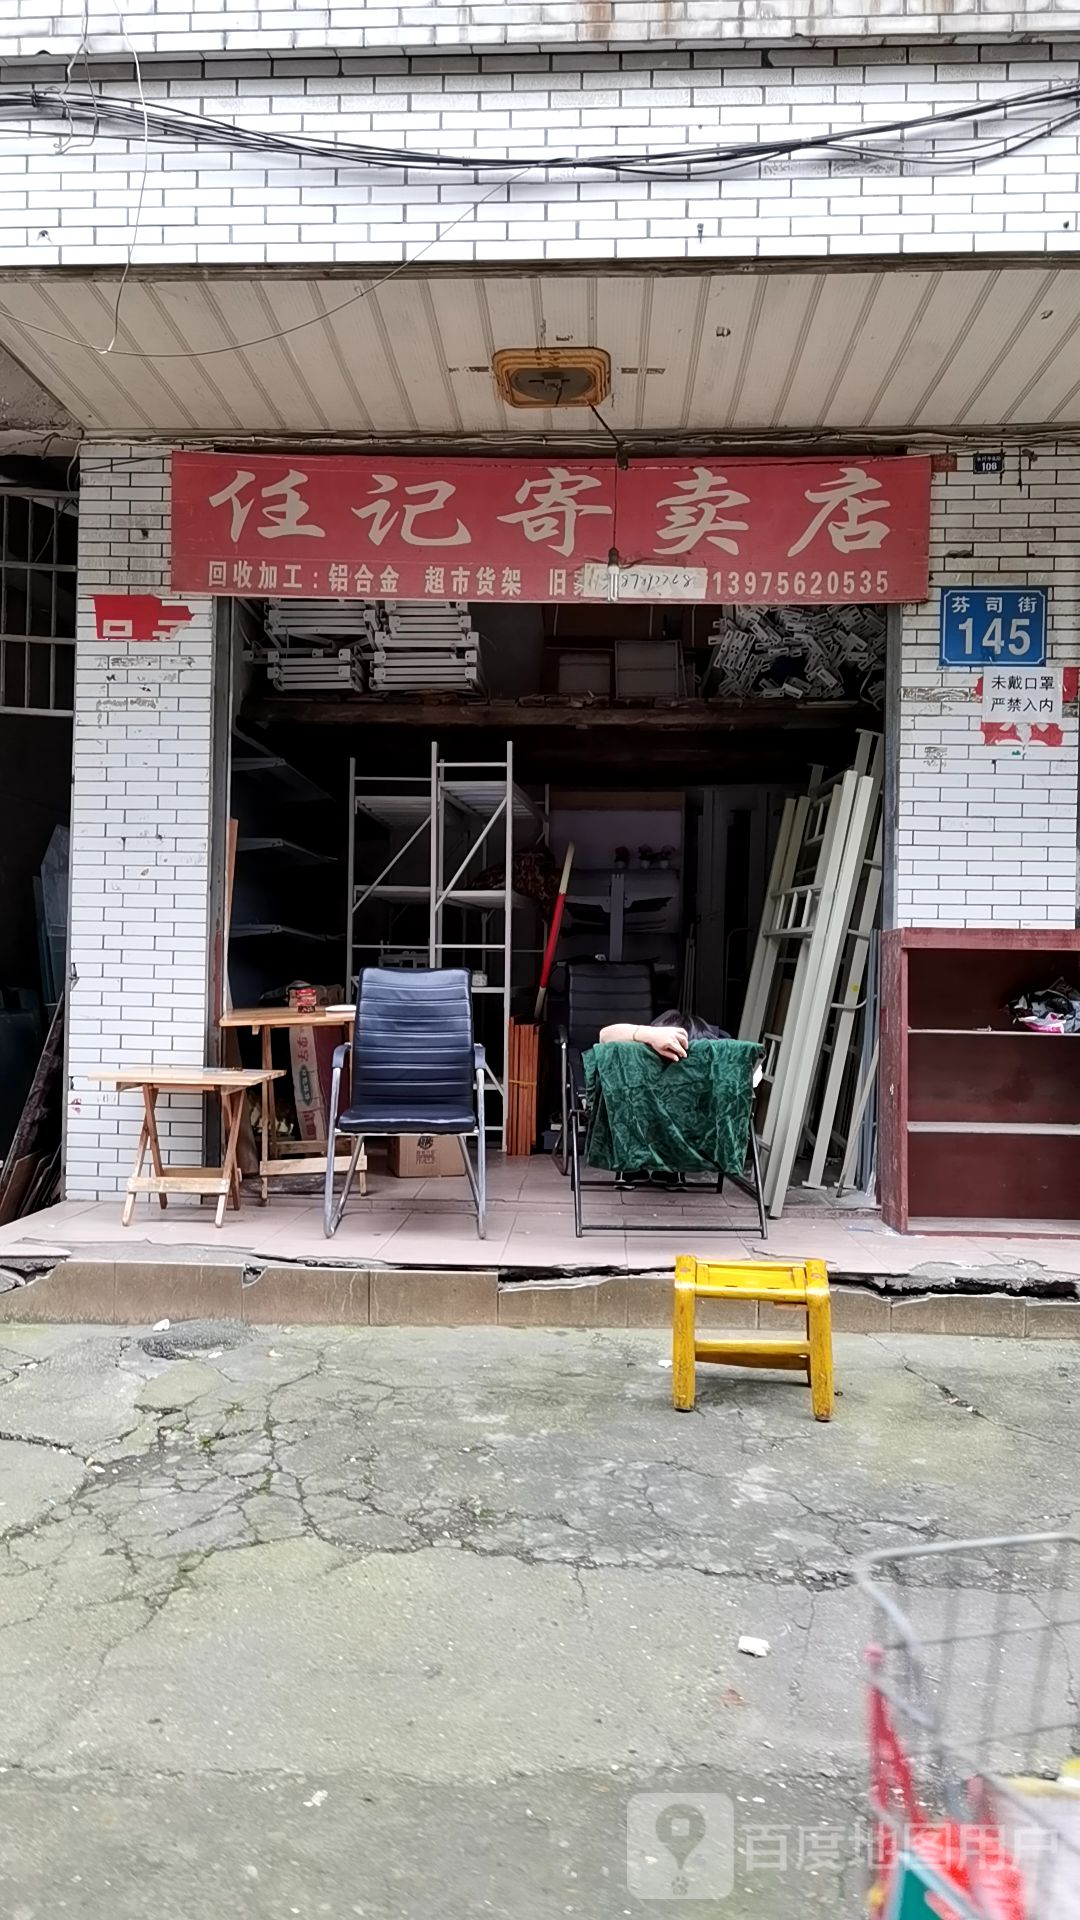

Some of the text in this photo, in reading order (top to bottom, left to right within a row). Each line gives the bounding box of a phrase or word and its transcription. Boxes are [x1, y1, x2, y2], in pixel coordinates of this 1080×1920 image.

[208, 467, 890, 558] 任记寄卖店
[424, 565, 522, 597] 超市货架
[712, 570, 889, 596] 13975620535
[951, 596, 1037, 614] 芬司街
[958, 617, 1031, 655] 145
[991, 675, 1055, 690] 未戴口罩
[990, 697, 1054, 713] 严禁入内
